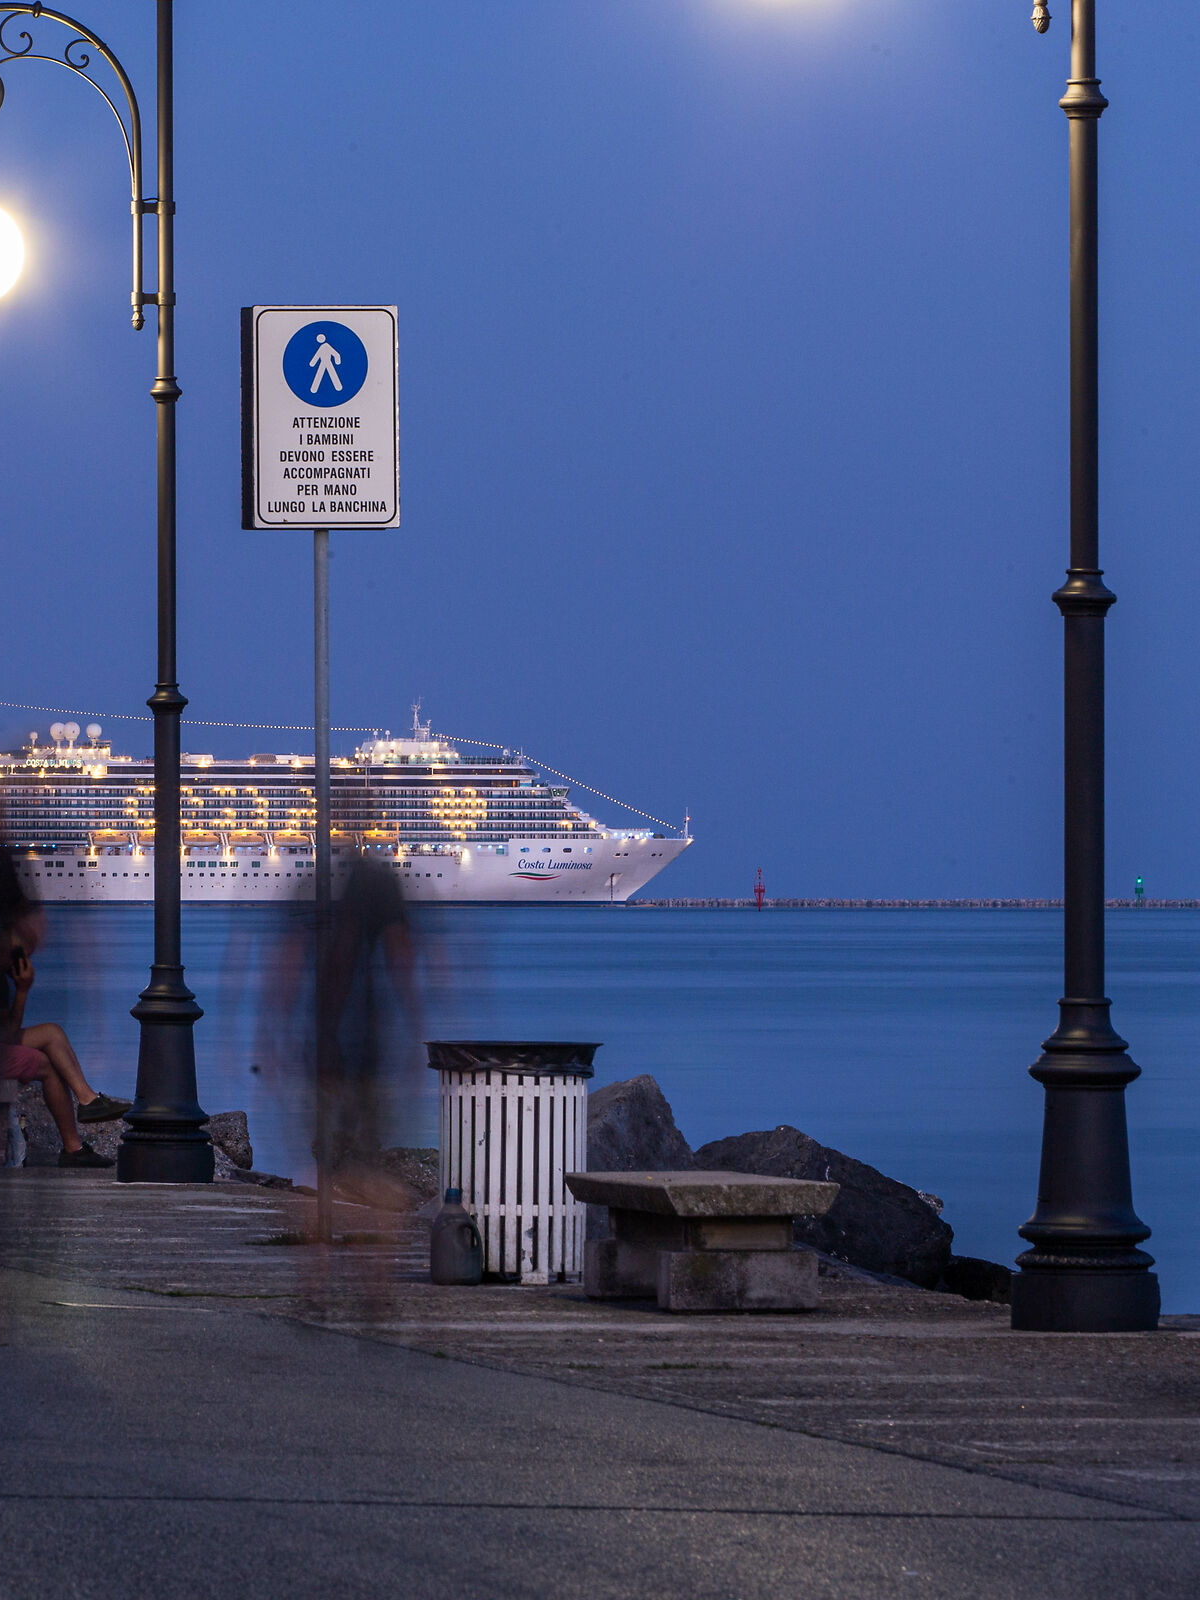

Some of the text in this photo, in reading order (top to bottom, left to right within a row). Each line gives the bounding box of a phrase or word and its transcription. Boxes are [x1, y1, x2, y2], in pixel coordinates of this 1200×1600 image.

[293, 417, 360, 428] ATTENZIONE
[299, 434, 353, 445] I BAMBINI
[280, 451, 373, 462] DEVONO ESSERE
[283, 467, 370, 479] ACCOMPAGNATI
[297, 484, 356, 495] PER MANO
[268, 501, 387, 513] LUNGO LA BANCHINA
[518, 859, 593, 870] Costa Luminosa
